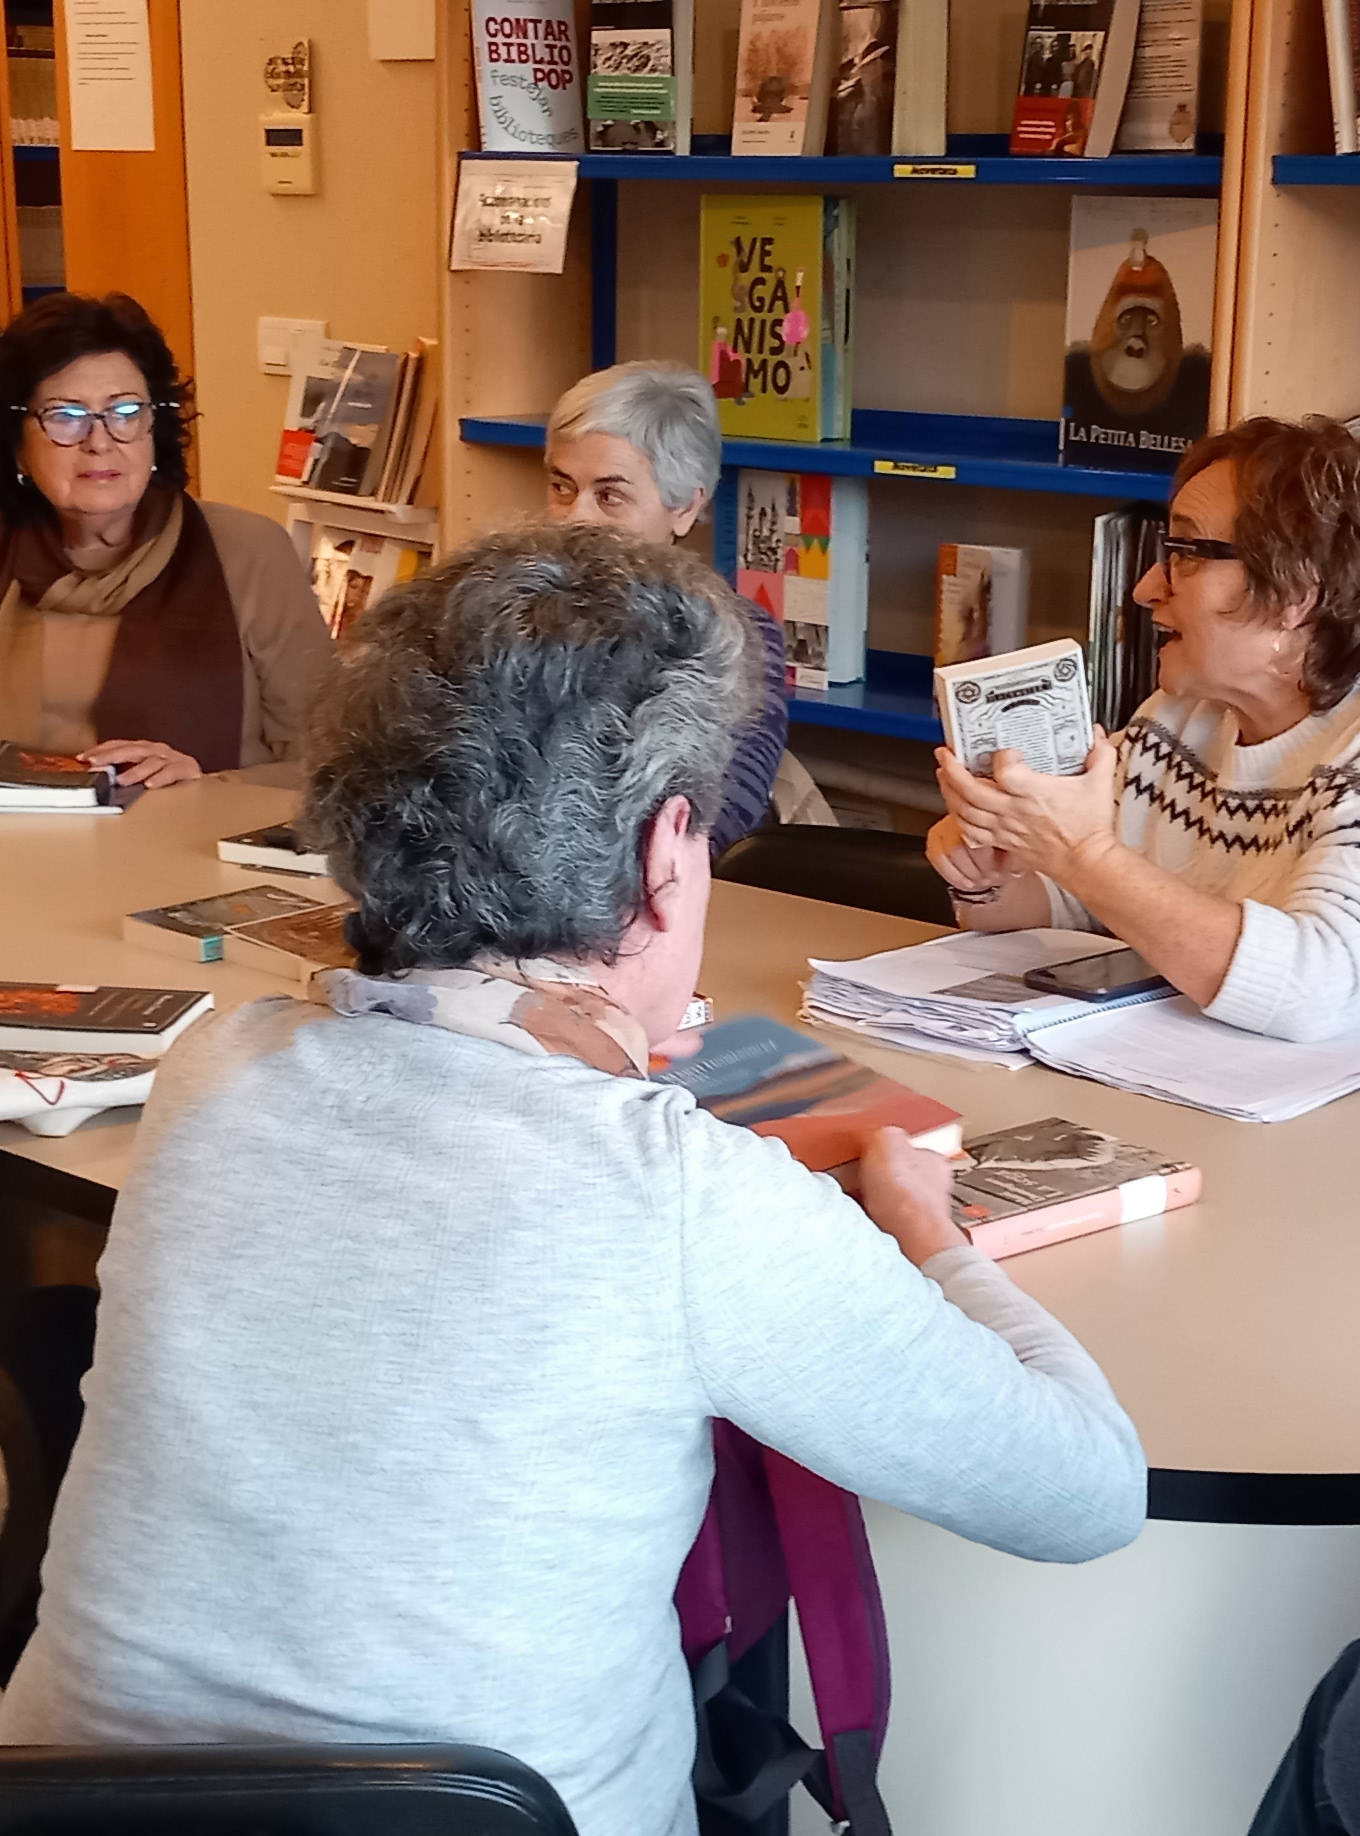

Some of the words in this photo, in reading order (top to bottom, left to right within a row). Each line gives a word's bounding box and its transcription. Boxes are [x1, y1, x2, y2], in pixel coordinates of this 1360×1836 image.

[485, 16, 571, 42] CONTAR
[487, 41, 572, 66] BIBLIO
[532, 67, 574, 90] POP
[734, 235, 775, 274] VE
[748, 277, 790, 314] GA
[732, 317, 786, 356] NIS
[745, 358, 792, 395] MO
[1069, 422, 1088, 441] LA
[1090, 425, 1136, 448] PETITA
